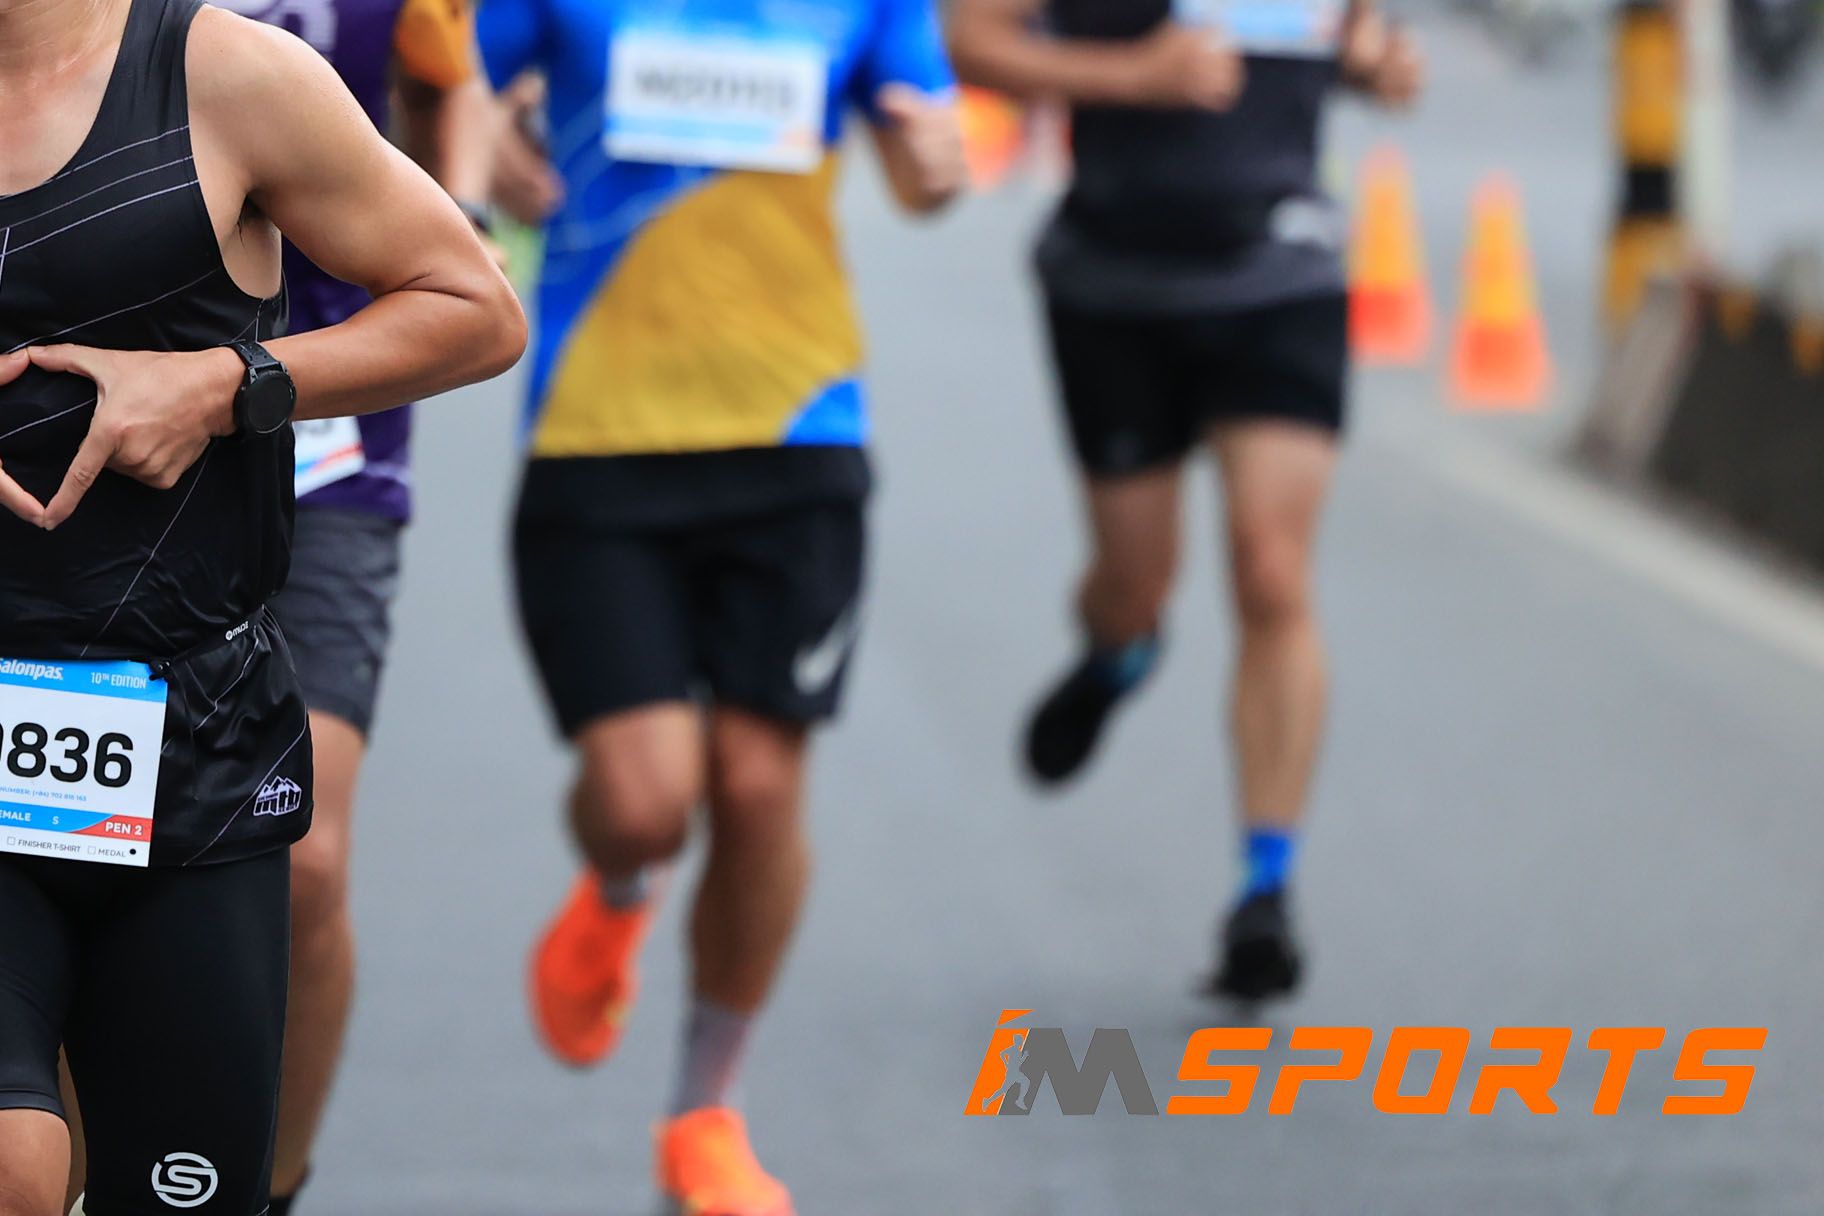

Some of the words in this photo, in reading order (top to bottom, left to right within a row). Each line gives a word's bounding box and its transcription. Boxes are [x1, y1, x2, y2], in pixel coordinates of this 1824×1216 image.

[111, 674, 146, 689] EDITION
[52, 816, 60, 825] S
[105, 821, 131, 835] PEN
[134, 825, 143, 836] 2
[18, 839, 52, 850] FINISHER
[53, 842, 81, 853] T-SHIRT
[97, 847, 126, 858] MEDAL
